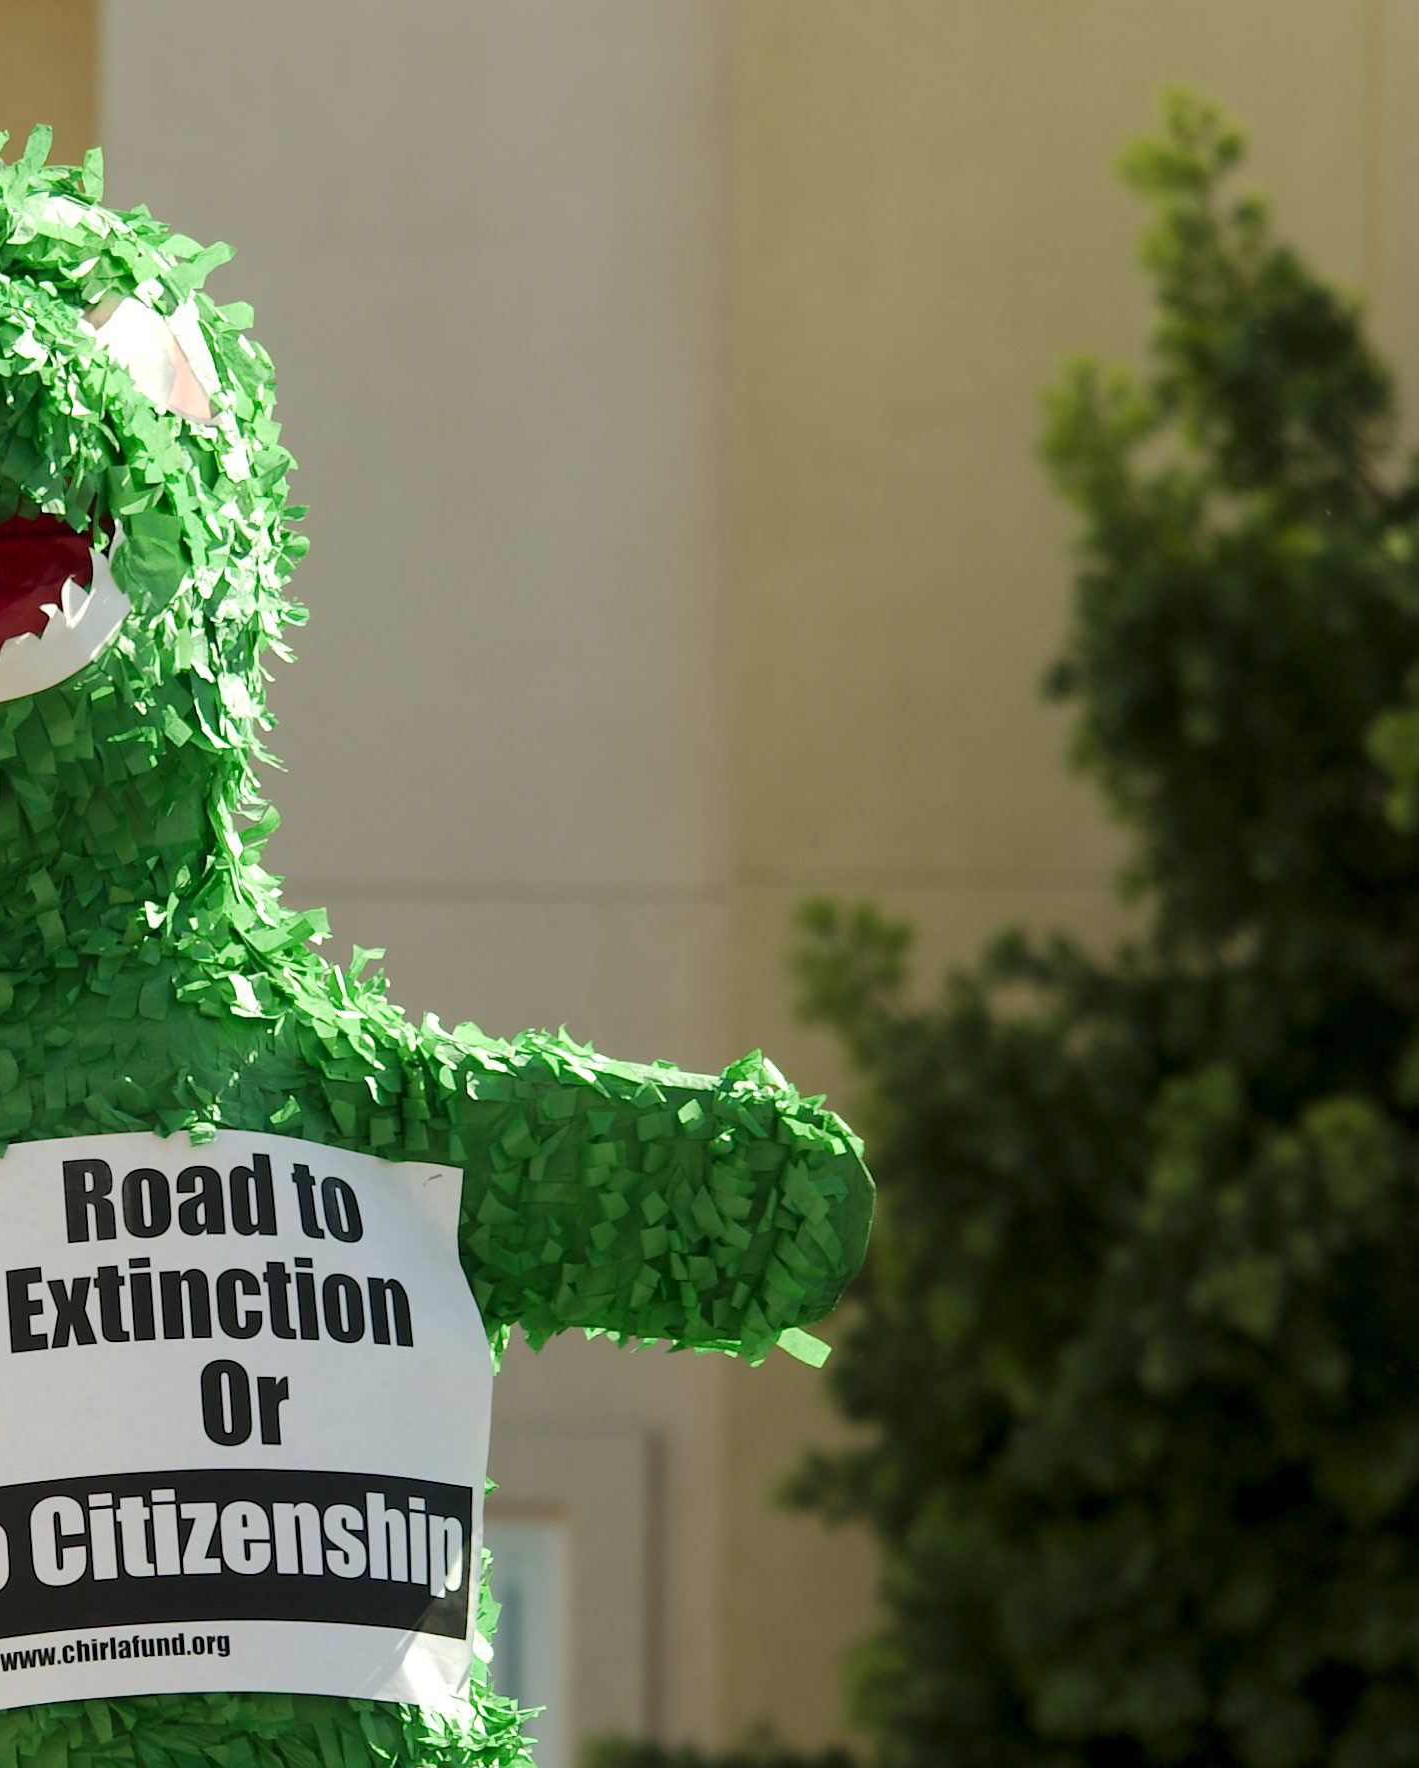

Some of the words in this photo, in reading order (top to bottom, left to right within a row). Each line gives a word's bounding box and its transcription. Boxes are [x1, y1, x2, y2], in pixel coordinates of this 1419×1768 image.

[61, 1153, 278, 1244] Road
[291, 1163, 364, 1244] to
[5, 1257, 414, 1354] Extinction
[200, 1358, 290, 1447] Or
[30, 1487, 466, 1599] Citizenship
[0, 1632, 231, 1672] www.chirlafund.org
